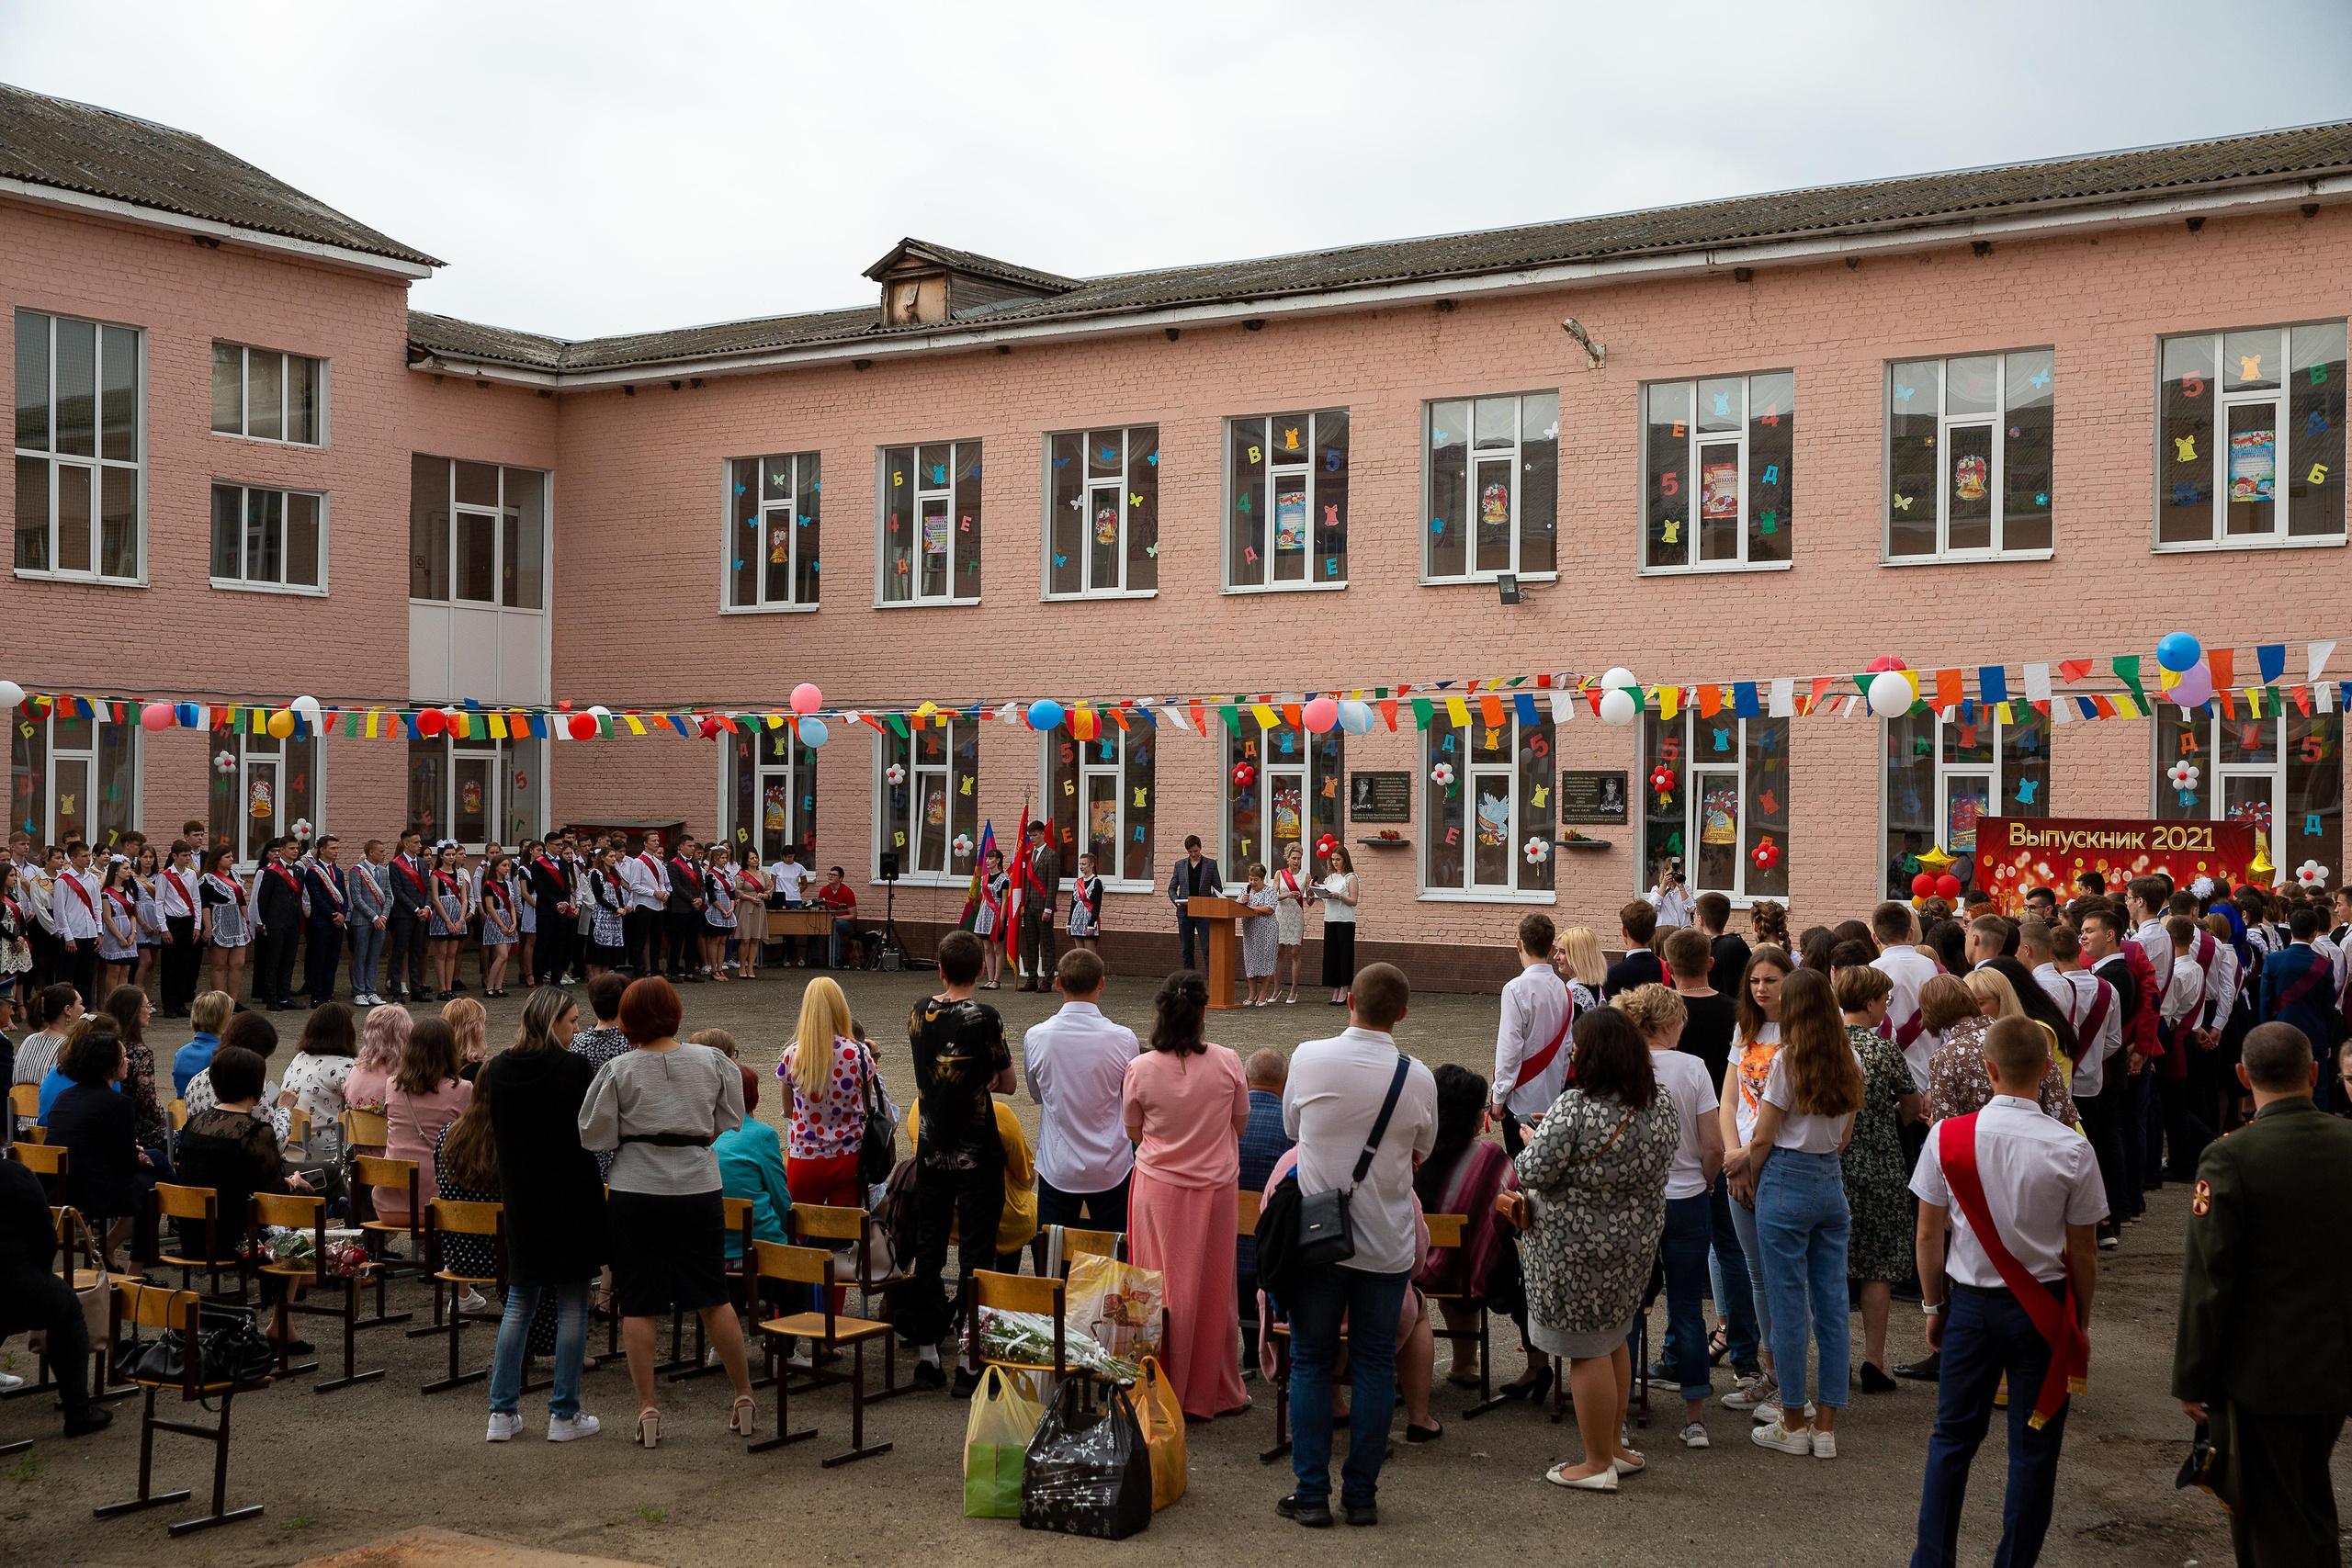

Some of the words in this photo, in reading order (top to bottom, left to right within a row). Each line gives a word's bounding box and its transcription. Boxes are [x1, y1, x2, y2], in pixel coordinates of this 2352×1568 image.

[2182, 369, 2204, 398] 5
[2309, 364, 2328, 385] В
[1761, 403, 1780, 428] 4
[1672, 419, 1686, 437] Е
[1248, 446, 1261, 465] В
[1326, 450, 1340, 471] 5
[893, 470, 903, 487] Б
[1661, 472, 1679, 496] 5
[1762, 465, 1778, 485] Д
[2306, 463, 2329, 485] Б
[1237, 492, 1250, 513] 4
[2176, 481, 2199, 507] 5
[888, 513, 899, 533] 4
[961, 514, 972, 533] Е
[1244, 546, 1258, 565] Д
[898, 558, 908, 576] Д
[967, 560, 978, 576] Г
[1326, 558, 1338, 576] Е
[19, 721, 35, 739] Б
[2018, 728, 2038, 751] 4
[897, 742, 906, 757] А
[962, 740, 974, 760] 4
[1245, 741, 1257, 759] Д
[1323, 736, 1338, 757] 4
[1442, 734, 1455, 753] Д
[1529, 733, 1549, 758] 5
[1661, 738, 1679, 761] 5
[1758, 729, 1777, 752] 4
[1917, 735, 1931, 754] А
[2180, 732, 2199, 755] Д
[2300, 737, 2323, 762] 5
[1060, 742, 1074, 763] 5
[1135, 746, 1148, 766] 4
[292, 773, 305, 794] 4
[515, 771, 527, 790] 5
[1063, 780, 1075, 795] Б
[803, 795, 812, 811] Е
[1902, 789, 1921, 813] 5
[737, 827, 749, 843] В
[1061, 827, 1073, 844] Е
[1134, 826, 1145, 843] Д
[2304, 815, 2323, 836] Д
[803, 830, 816, 851] 5
[894, 830, 905, 848] В
[1444, 827, 1460, 846] Е
[1667, 832, 1683, 854] 4
[2009, 823, 2145, 854] Выпускник
[2152, 826, 2215, 852] 2021
[1241, 839, 1251, 856] Г
[1904, 853, 1920, 874] В
[1102, 1487, 1111, 1506] 30кг
